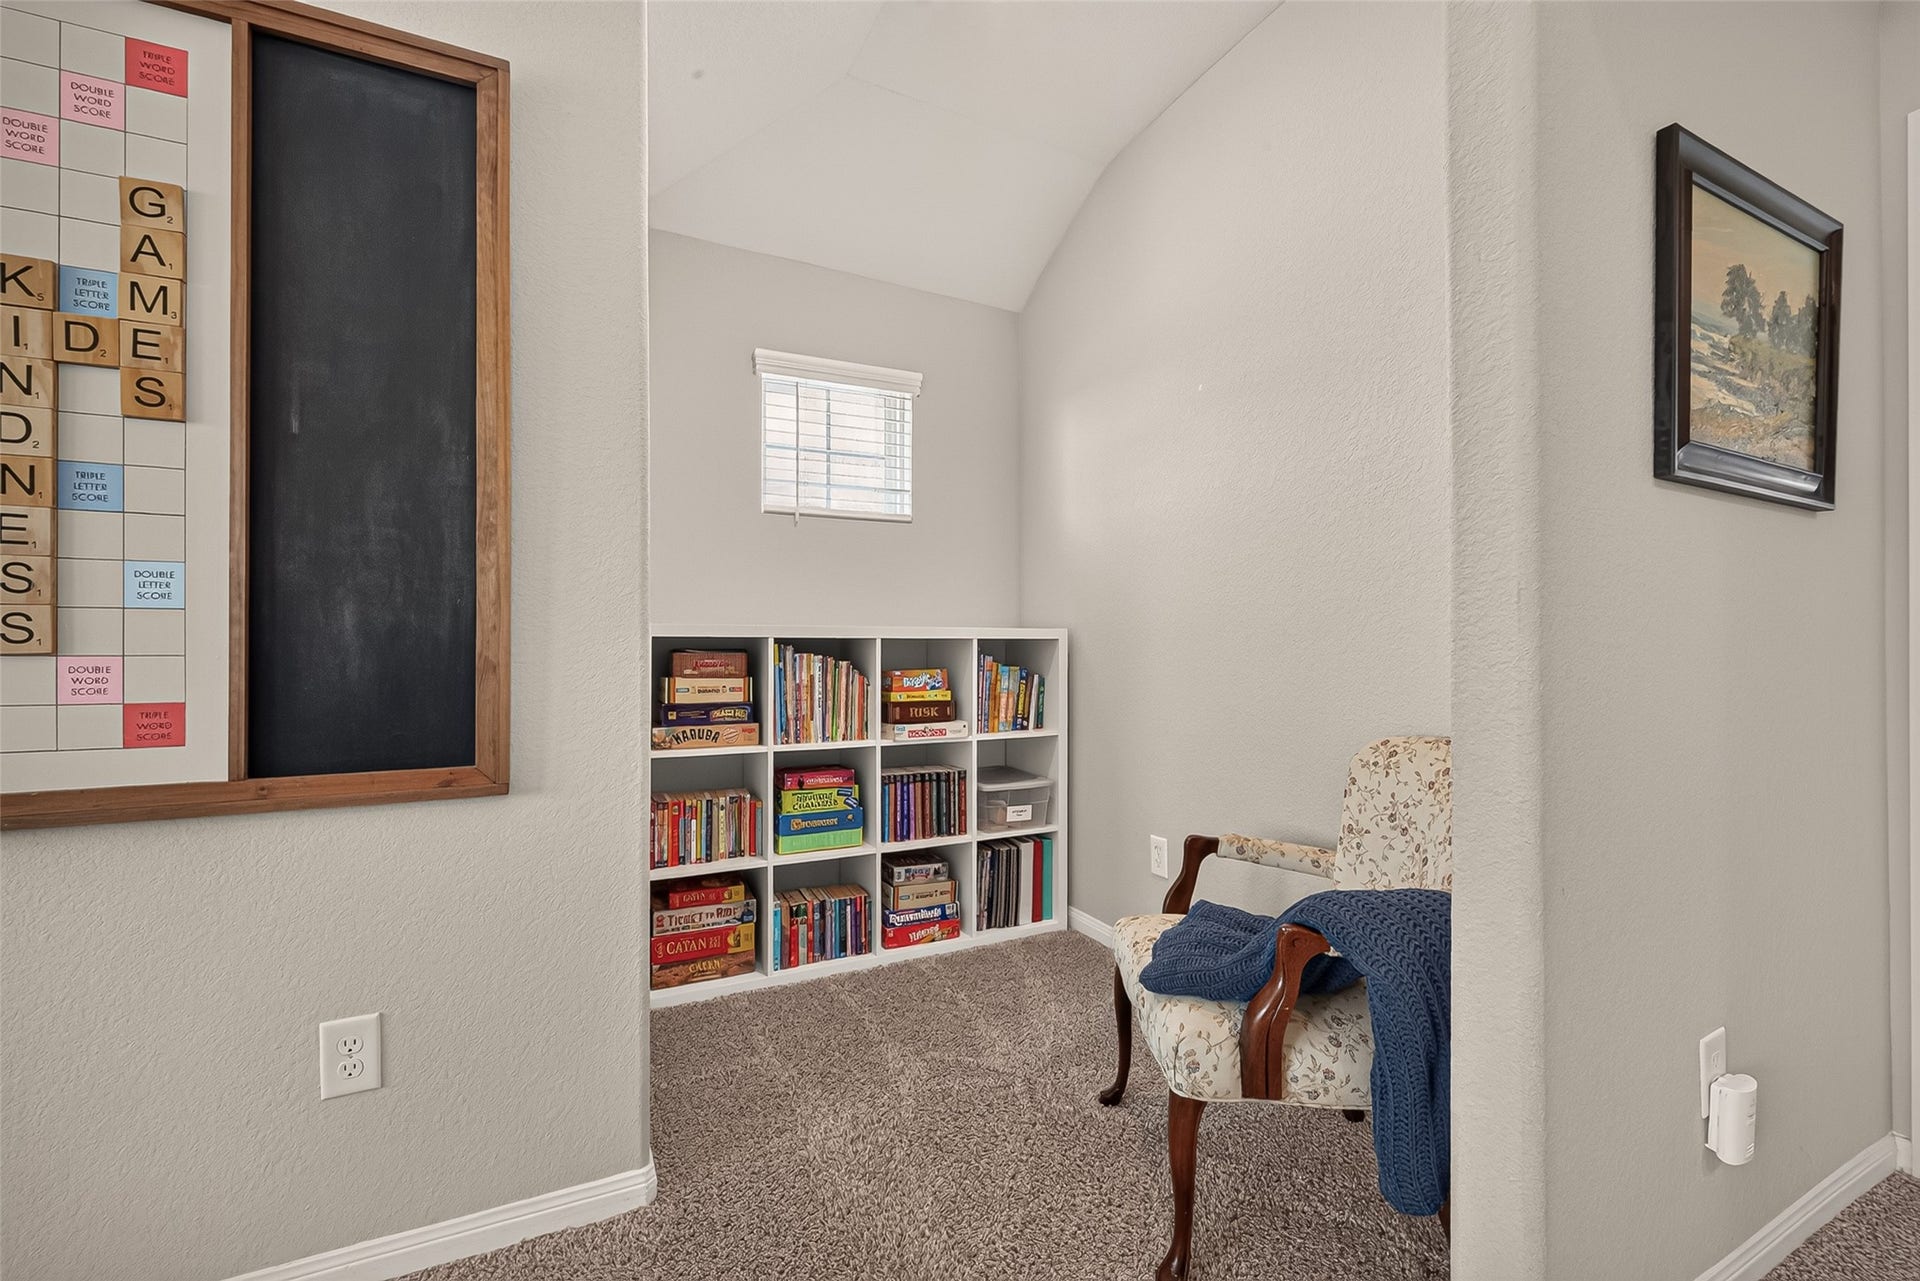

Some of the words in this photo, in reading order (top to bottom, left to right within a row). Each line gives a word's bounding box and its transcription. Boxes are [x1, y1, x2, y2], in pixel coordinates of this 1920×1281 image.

[139, 61, 175, 76] WORD
[139, 71, 175, 85] SCORE
[71, 81, 114, 98] DOUBLE
[73, 93, 112, 108] WORD
[73, 104, 111, 119] SCORE
[2, 116, 48, 133] DOUBLE
[6, 128, 45, 144] WORD
[5, 140, 45, 155] SCORE
[76, 276, 107, 290] TRIPLE
[74, 287, 109, 300] LETTER
[73, 297, 110, 311] SCORE
[75, 470, 106, 481] TRIPLE
[73, 481, 107, 491] LETTER
[72, 492, 109, 503] SCORE
[134, 569, 175, 580] DOUBLE
[138, 580, 171, 590] LETTER
[136, 591, 173, 600] SCORE
[68, 665, 112, 675] DOUBLE
[70, 676, 109, 685] WORD
[71, 687, 109, 696] SCORE
[910, 707, 938, 717] RISK
[136, 721, 173, 731] WORD
[136, 731, 172, 742] SCORE
[667, 937, 706, 954] CATAN
